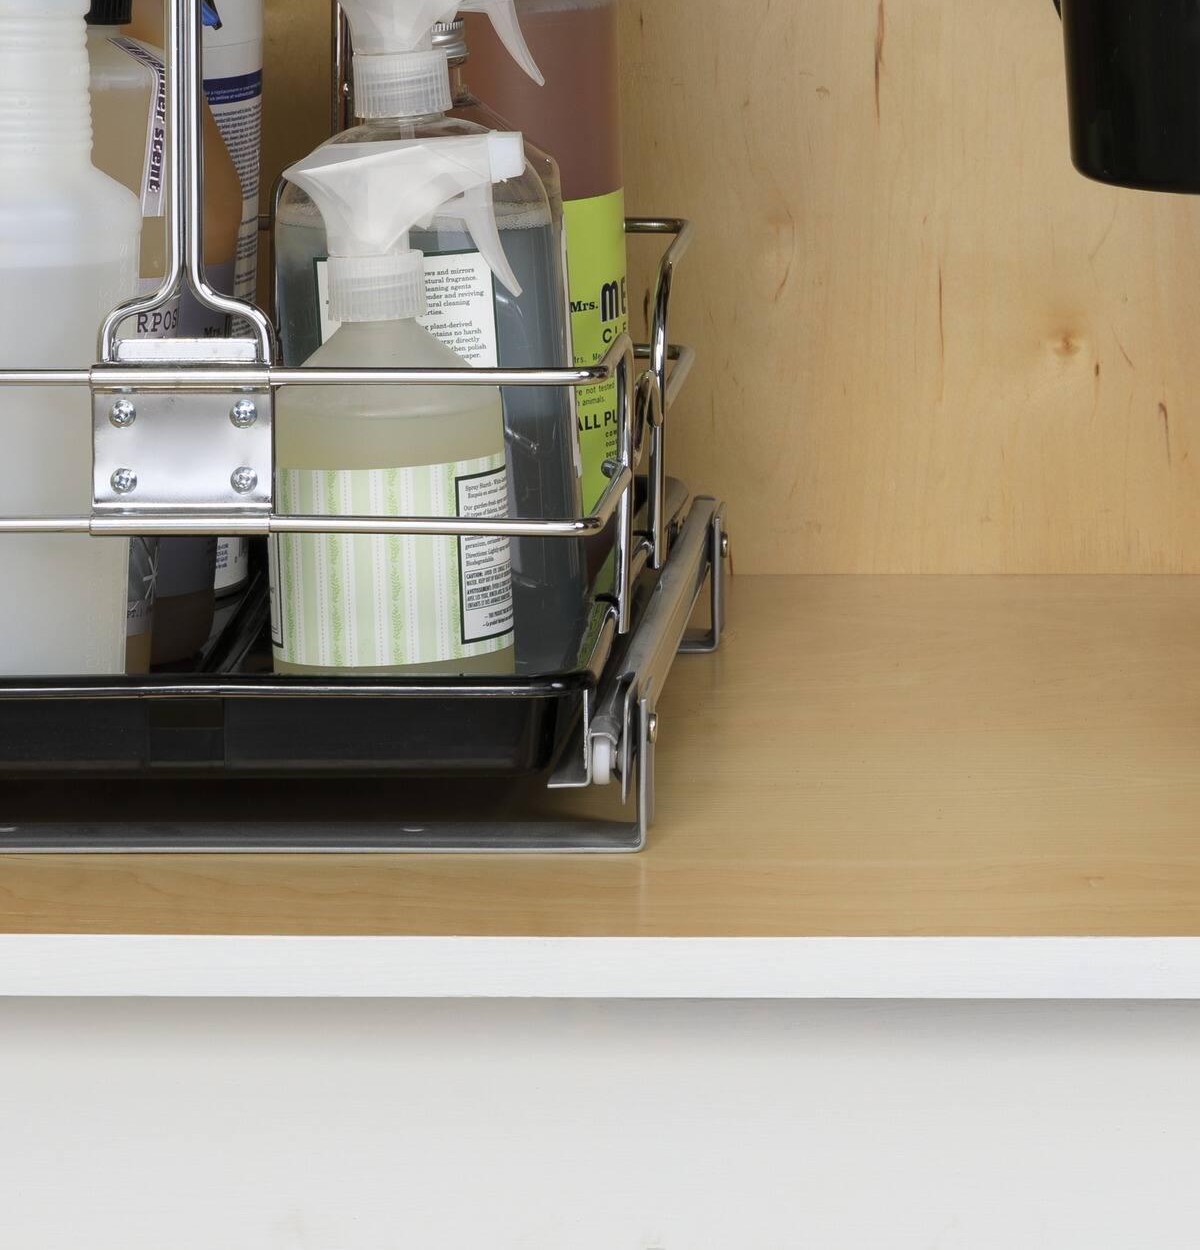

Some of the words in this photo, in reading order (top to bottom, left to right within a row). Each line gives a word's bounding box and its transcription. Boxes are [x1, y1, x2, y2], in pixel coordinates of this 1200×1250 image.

[148, 127, 164, 193] scent
[458, 290, 484, 298] reviving
[455, 336, 480, 344] directly
[467, 343, 487, 352] polish
[586, 387, 596, 395] not
